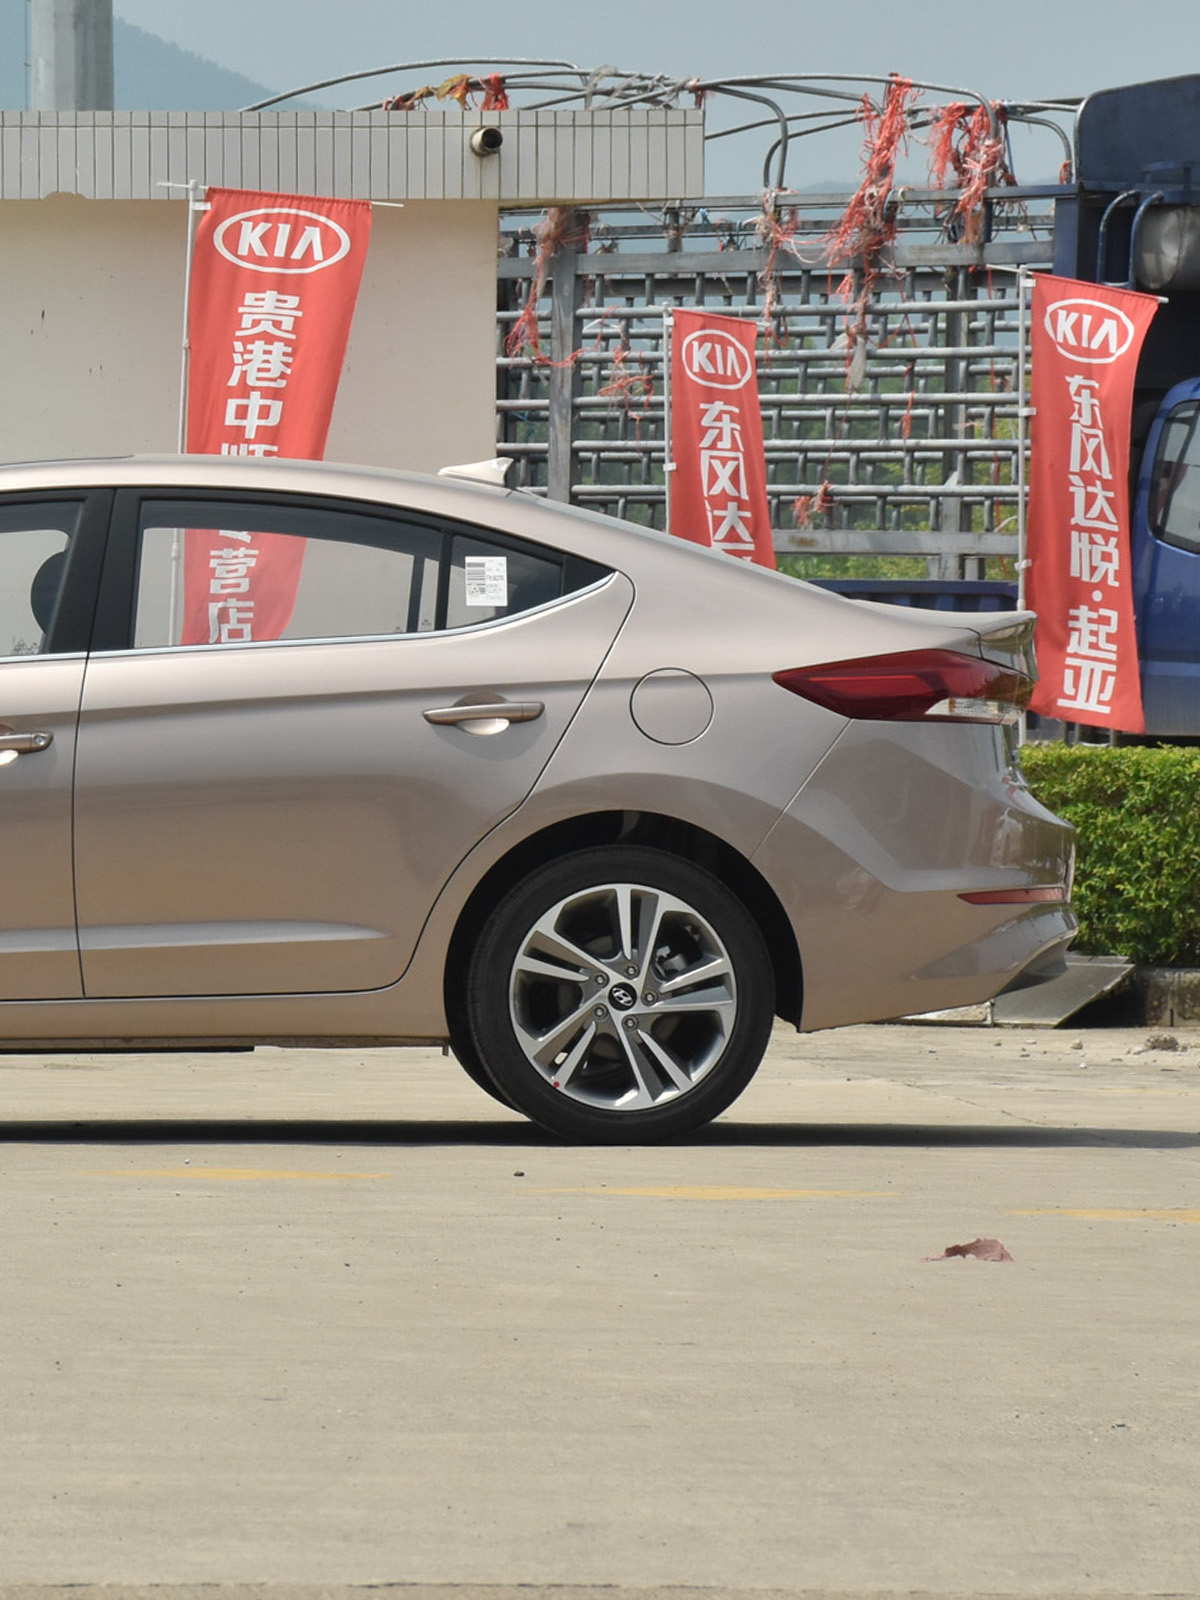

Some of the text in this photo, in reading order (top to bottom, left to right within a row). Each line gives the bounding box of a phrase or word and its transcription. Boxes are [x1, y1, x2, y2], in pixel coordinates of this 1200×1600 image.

[237, 219, 324, 262] KIA
[1056, 309, 1119, 353] KIA
[691, 340, 743, 379] KIA
[698, 400, 755, 558] 东风达
